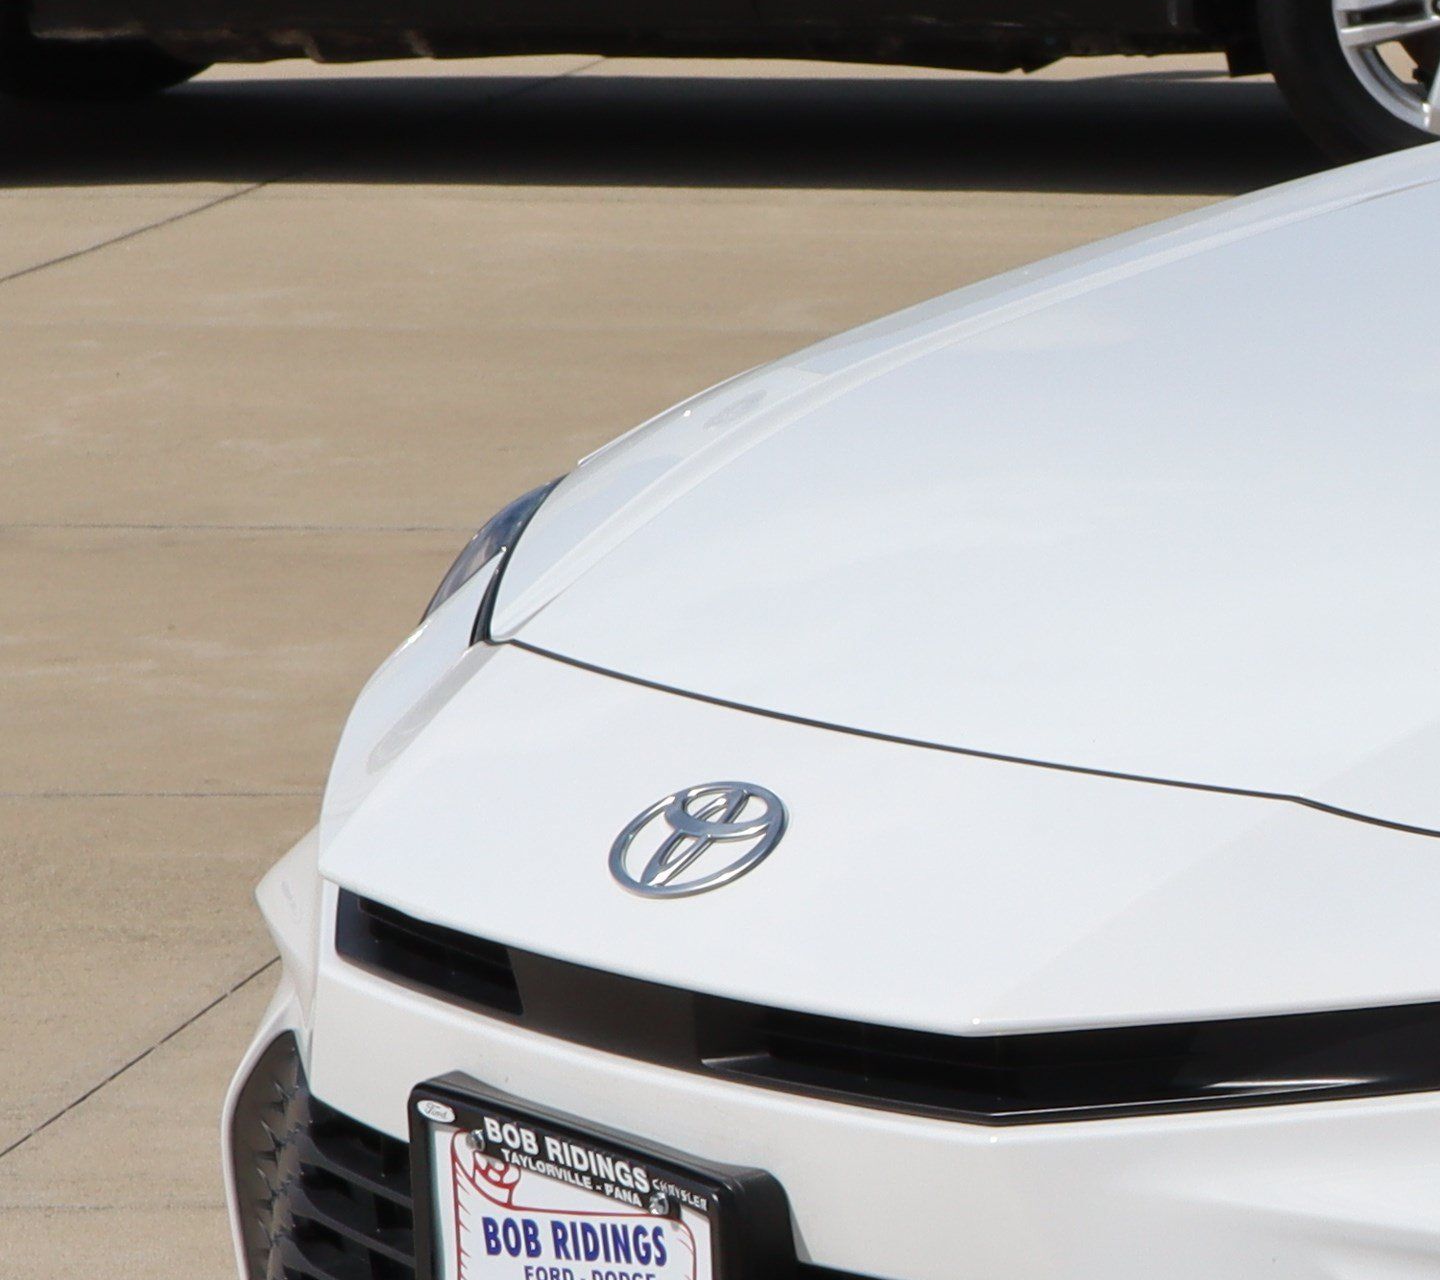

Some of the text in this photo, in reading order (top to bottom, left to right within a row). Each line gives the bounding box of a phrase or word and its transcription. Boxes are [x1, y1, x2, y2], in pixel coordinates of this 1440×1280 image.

[484, 1116, 651, 1194] BOB RIDINGS
[501, 1148, 594, 1191] TAYLORVILLE
[604, 1182, 643, 1208] PANA
[652, 1178, 708, 1212] CHRYSLER
[482, 1216, 668, 1267] BOB RIDINGS
